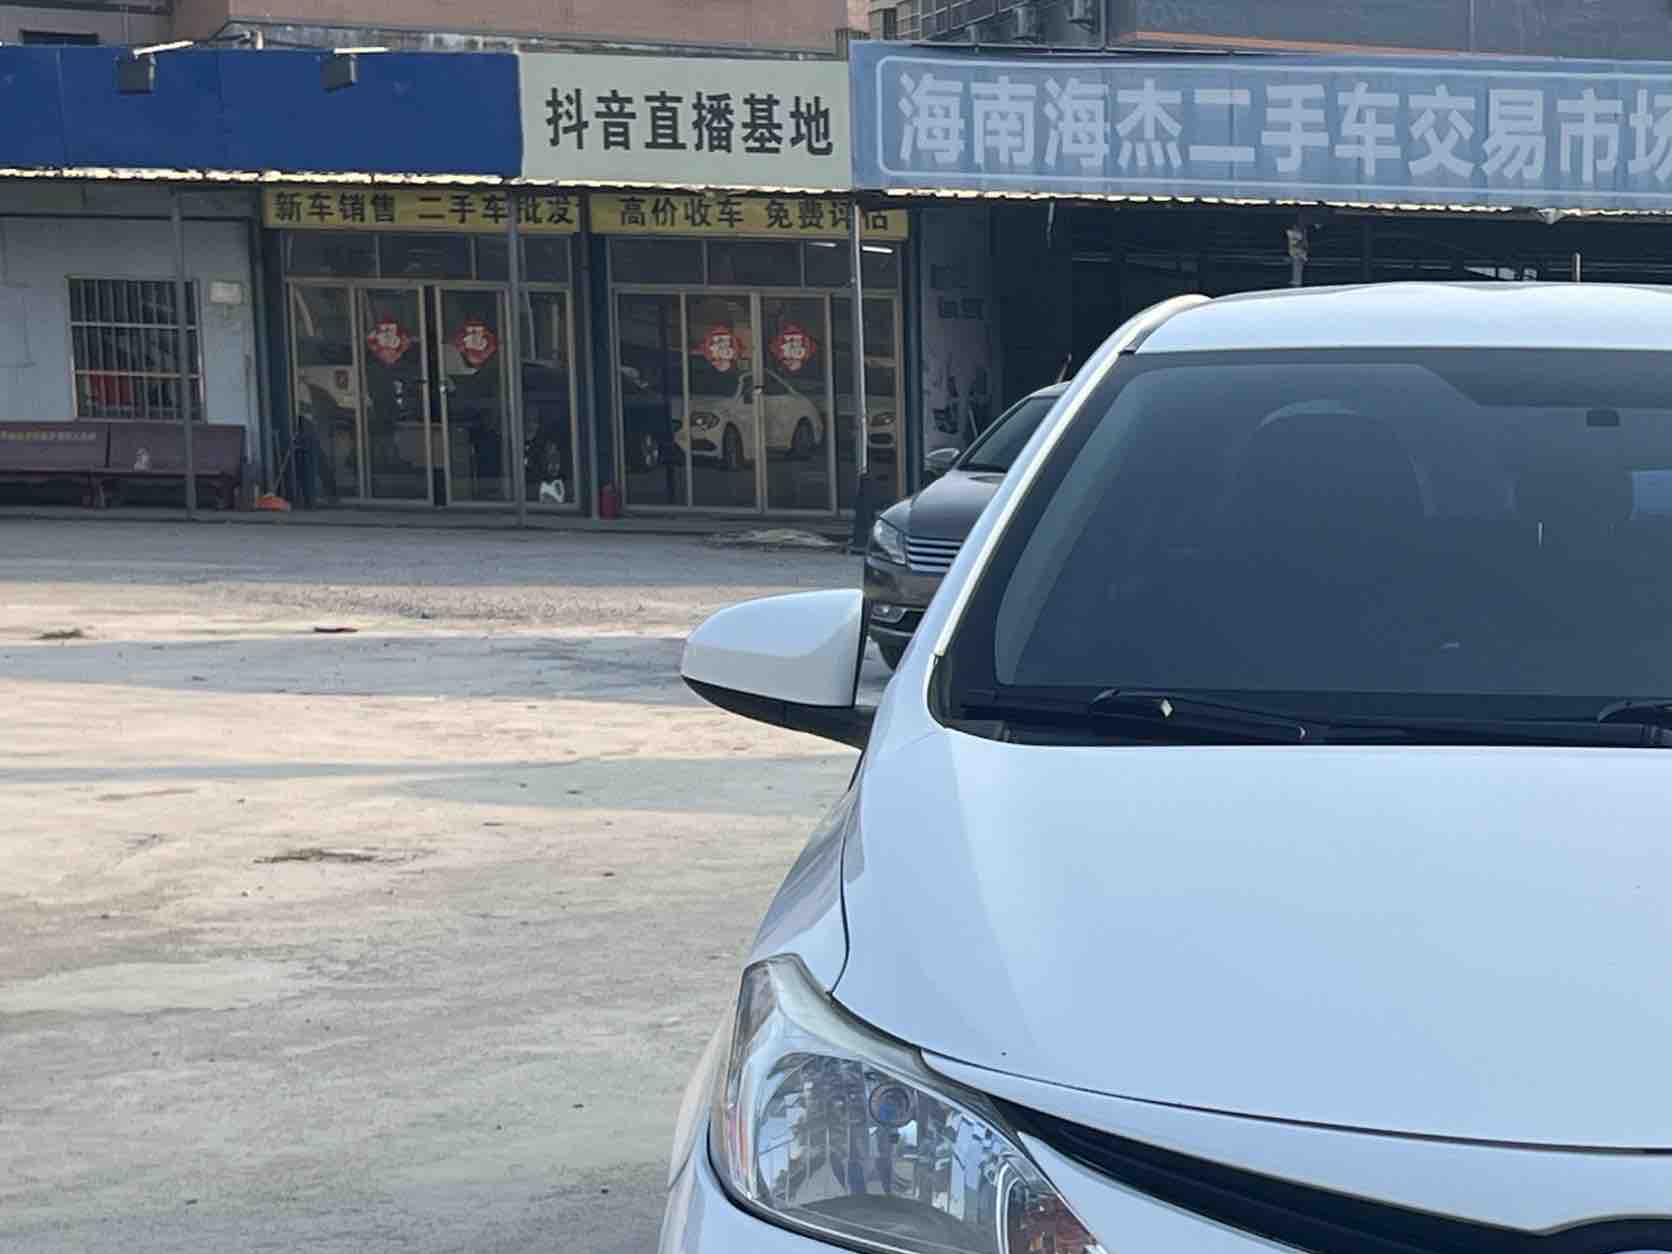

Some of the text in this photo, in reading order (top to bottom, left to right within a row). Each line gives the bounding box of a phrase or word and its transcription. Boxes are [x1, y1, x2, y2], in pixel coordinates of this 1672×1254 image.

[545, 87, 833, 156] 抖音直播基地
[275, 191, 575, 225] 新车销售 二手车批发
[619, 197, 745, 228] 高价收车
